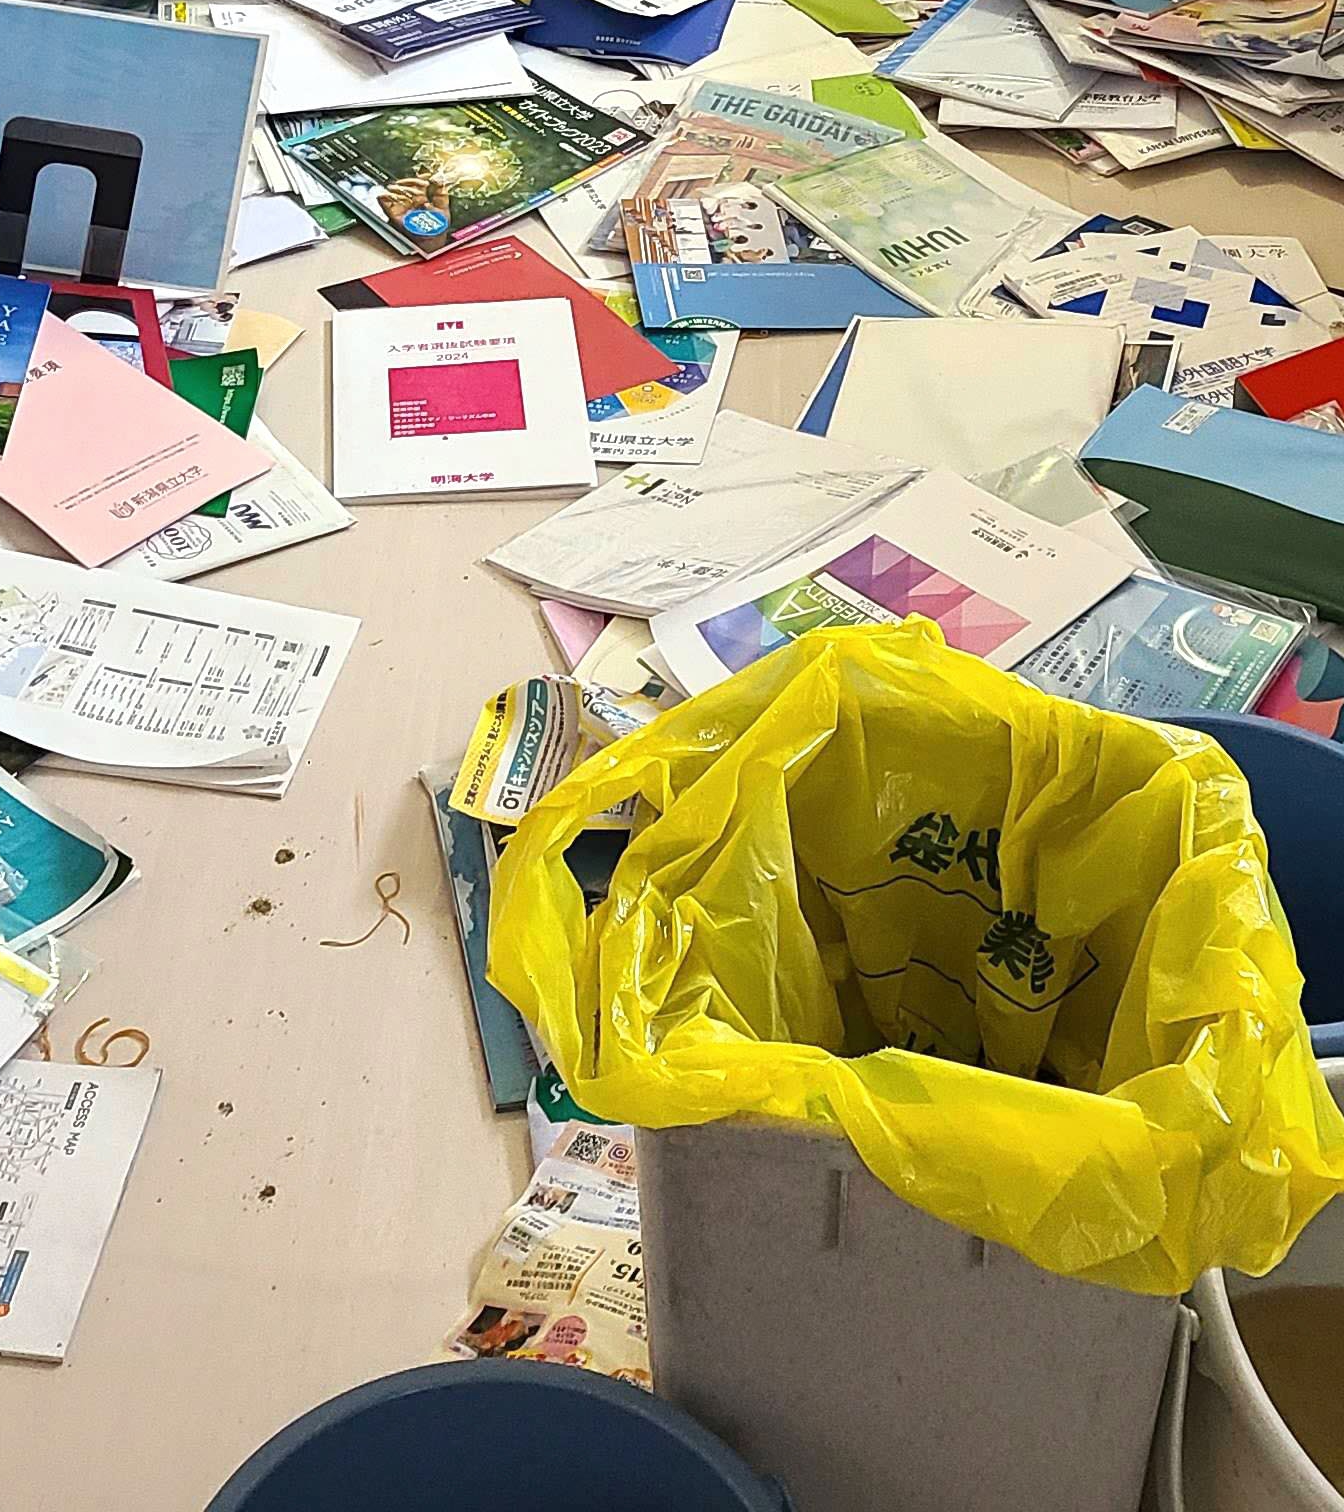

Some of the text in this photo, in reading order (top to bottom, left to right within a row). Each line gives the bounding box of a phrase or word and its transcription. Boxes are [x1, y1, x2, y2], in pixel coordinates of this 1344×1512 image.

[710, 92, 854, 144] THE GAIDAI
[877, 225, 969, 270] IUHW
[435, 350, 470, 363] 2024
[430, 470, 496, 486] 明海大学
[72, 1081, 99, 1128] ACCESS
